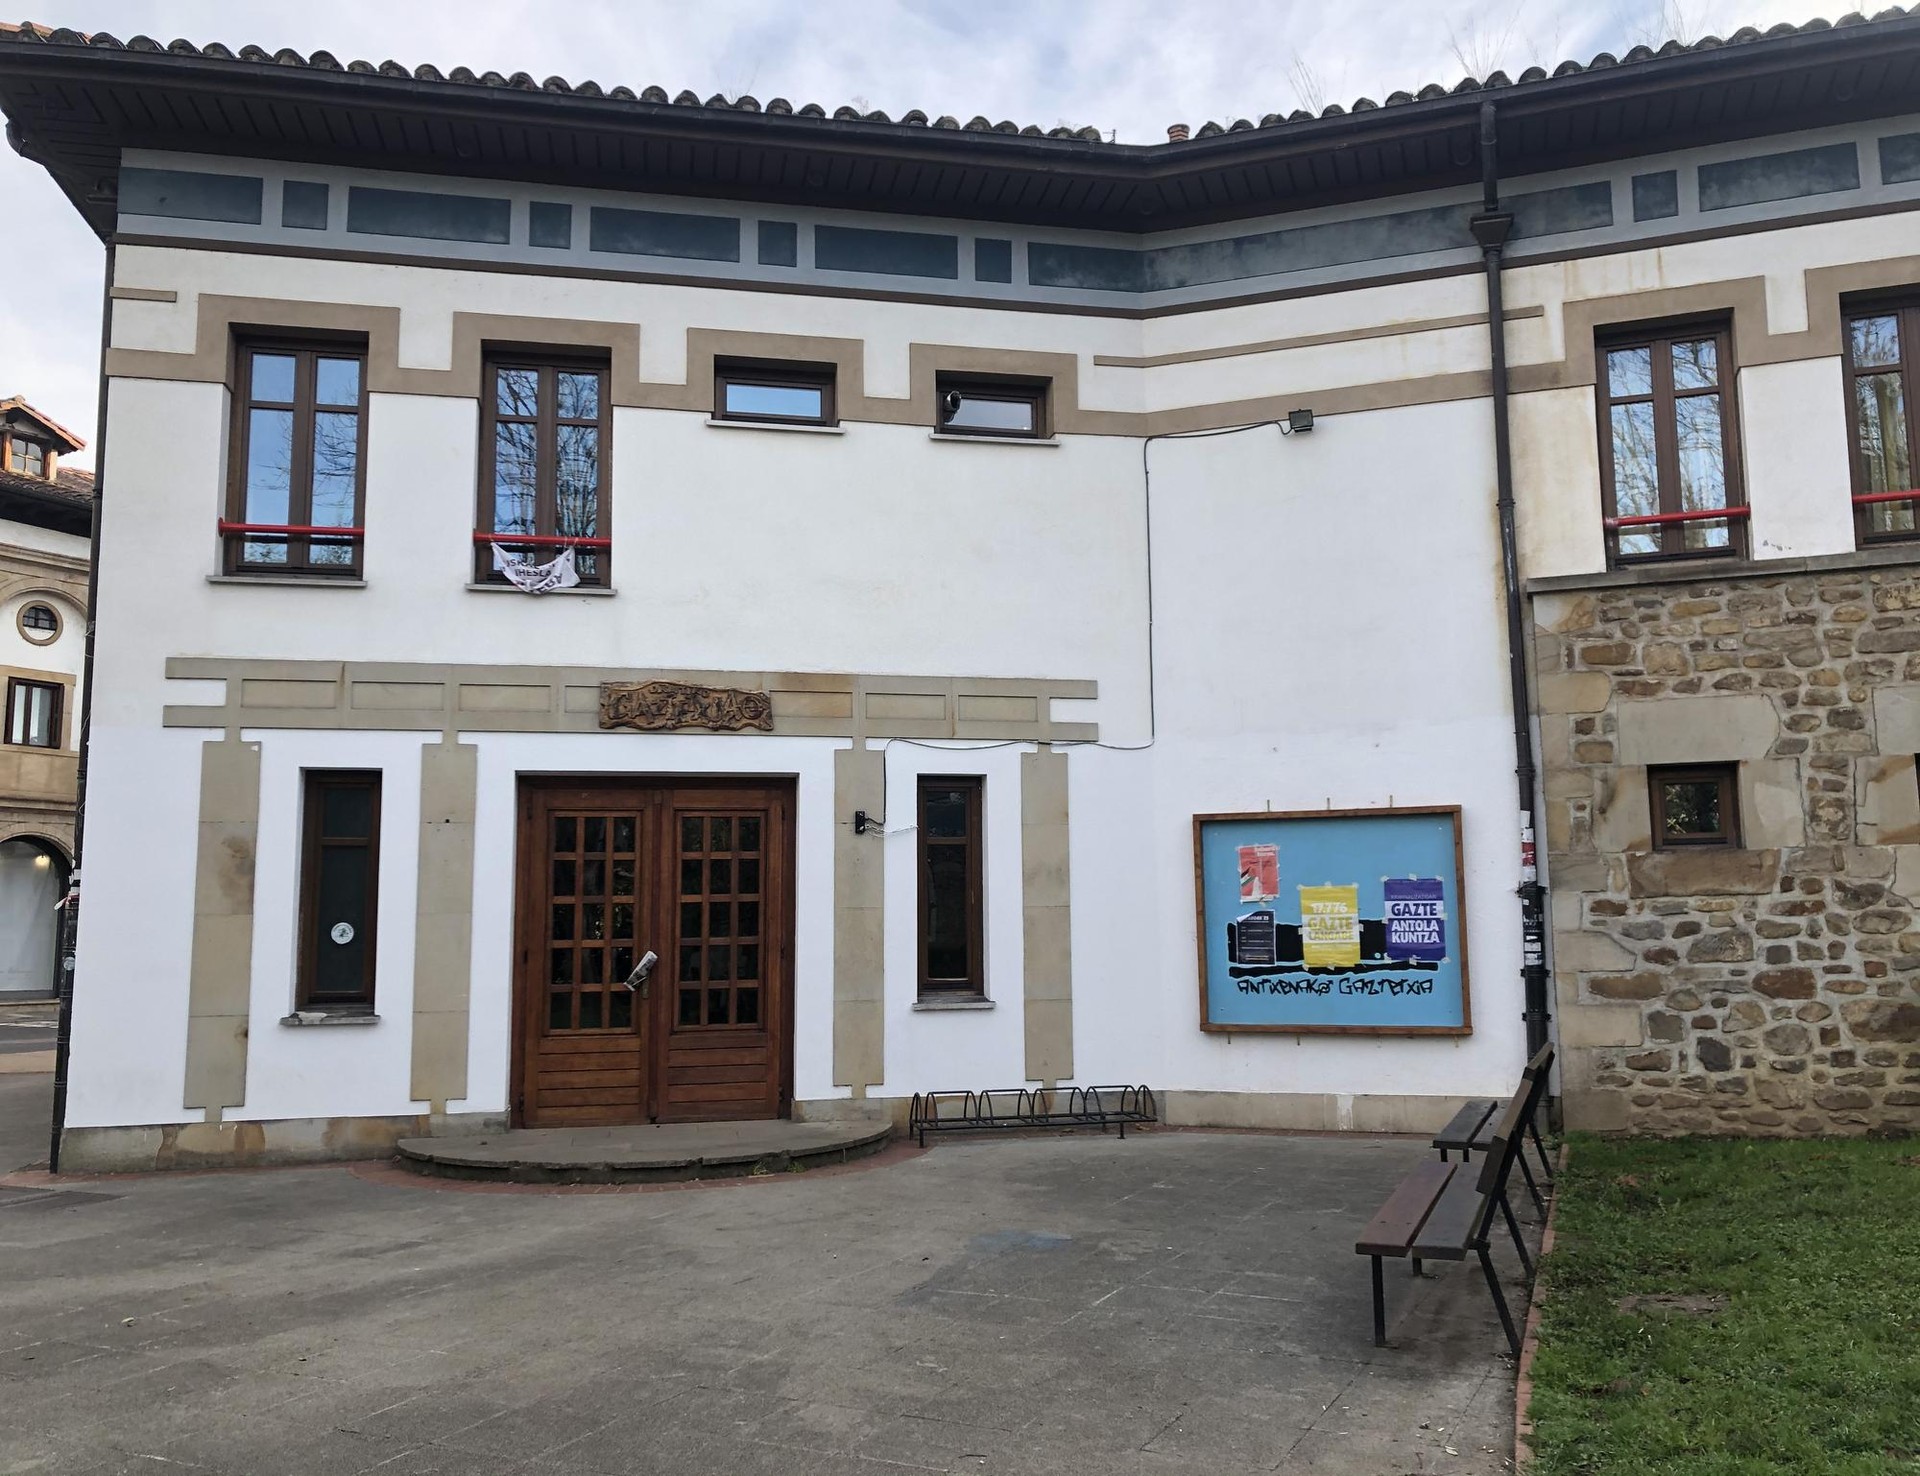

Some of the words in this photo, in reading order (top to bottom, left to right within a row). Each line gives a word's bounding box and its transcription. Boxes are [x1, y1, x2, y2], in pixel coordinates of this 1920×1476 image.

[1391, 902, 1438, 917] GAZTE
[1308, 916, 1353, 931] GAZTE
[1391, 920, 1440, 931] ANTOLA
[1391, 931, 1441, 943] KUNTZA
